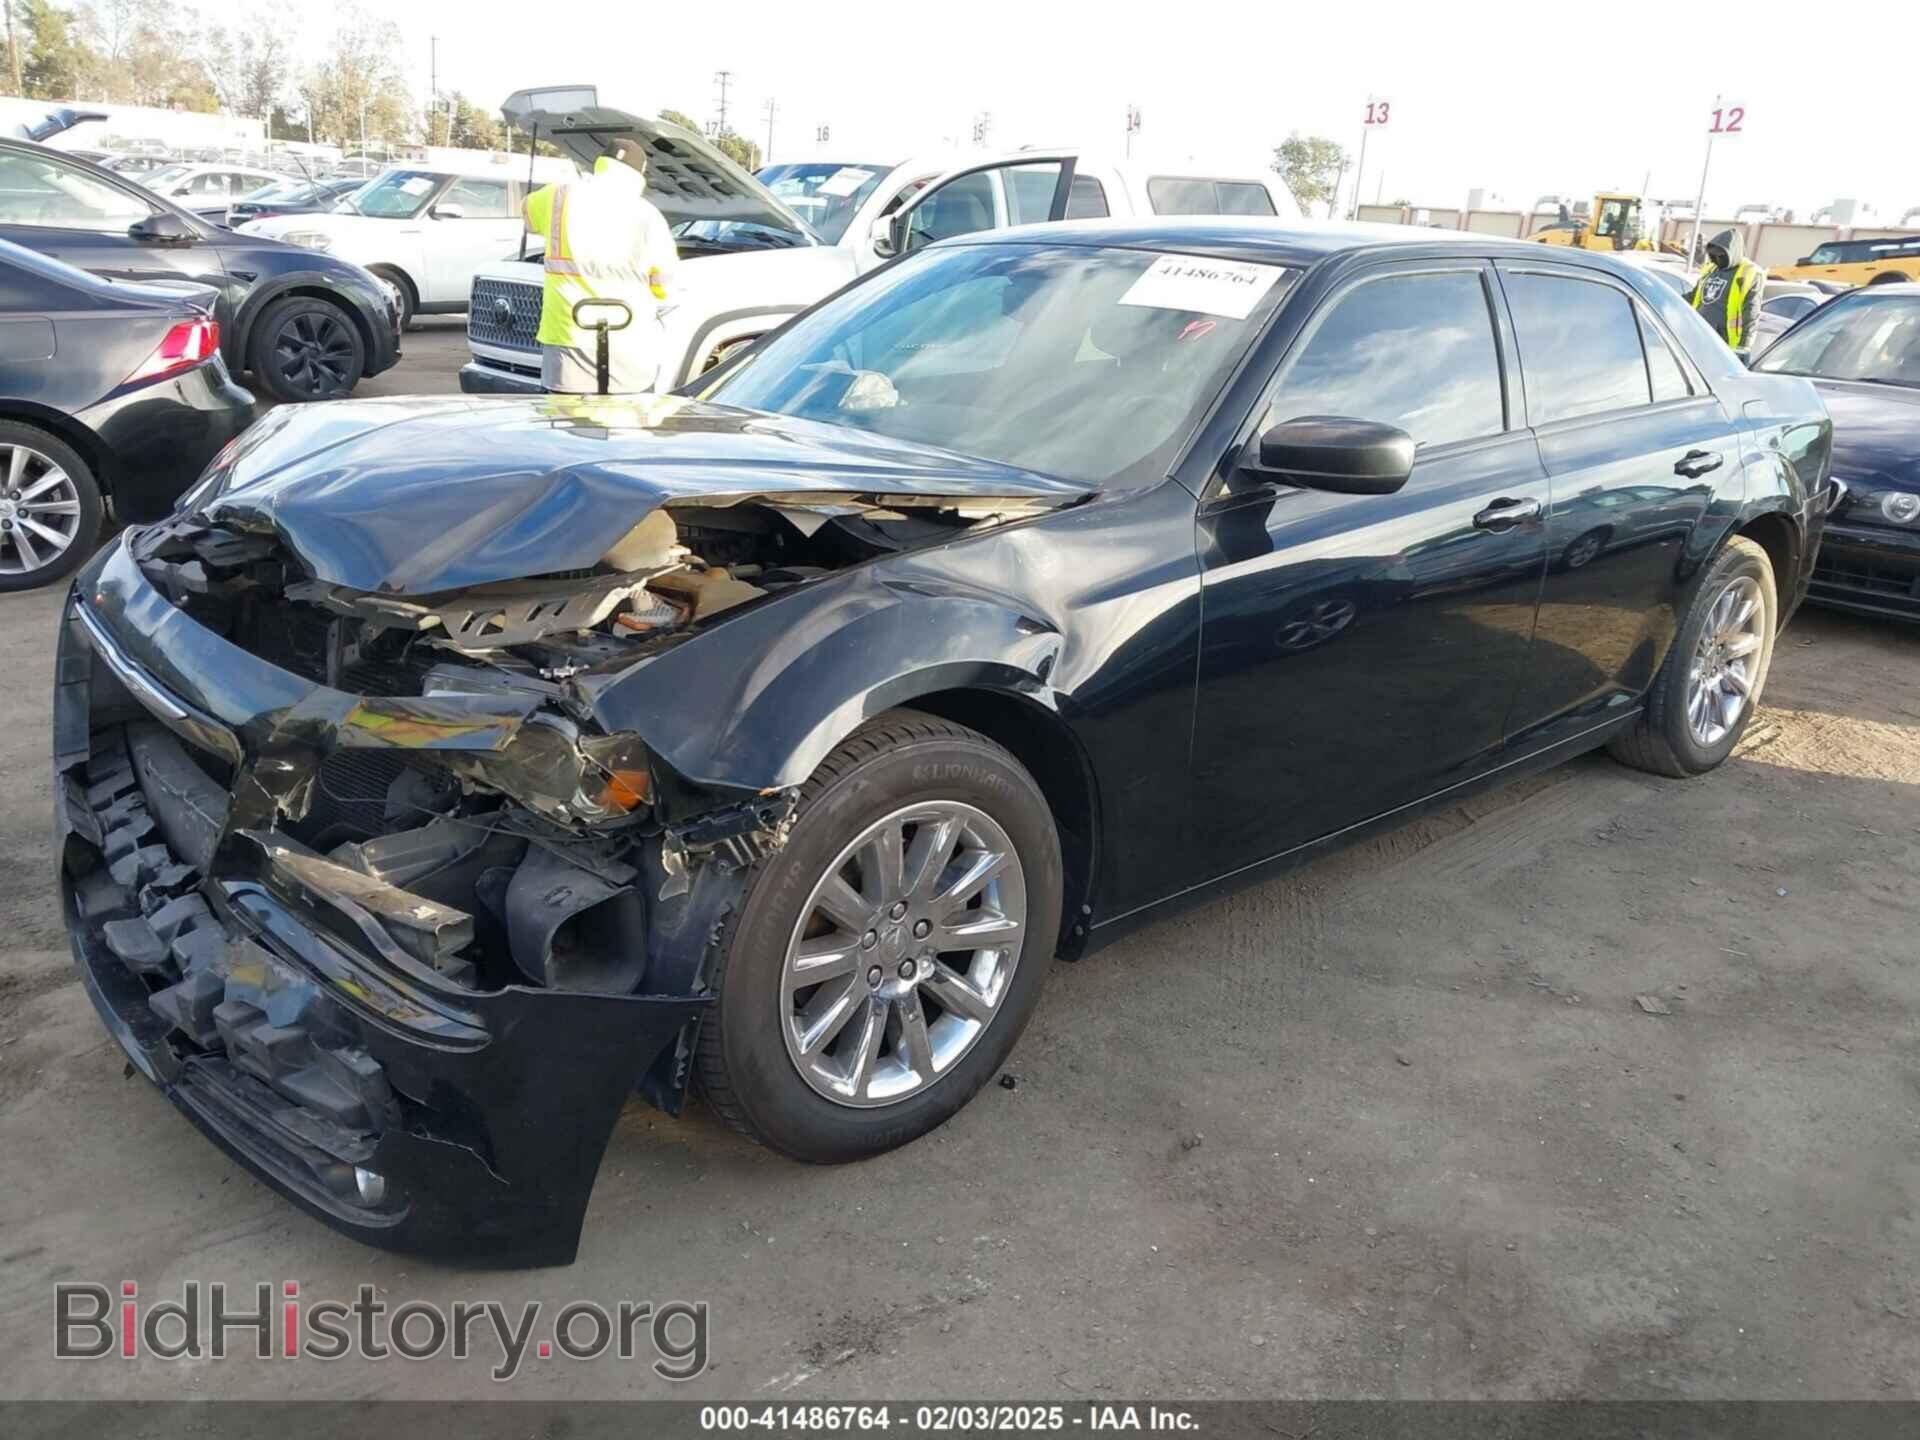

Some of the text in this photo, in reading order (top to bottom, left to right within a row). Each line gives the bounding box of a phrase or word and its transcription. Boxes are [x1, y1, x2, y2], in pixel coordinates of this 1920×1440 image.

[1126, 111, 1142, 132] 14
[1363, 101, 1390, 125] 13
[1708, 107, 1745, 133] 12
[815, 125, 830, 142] 16
[1158, 264, 1258, 286] 41486764
